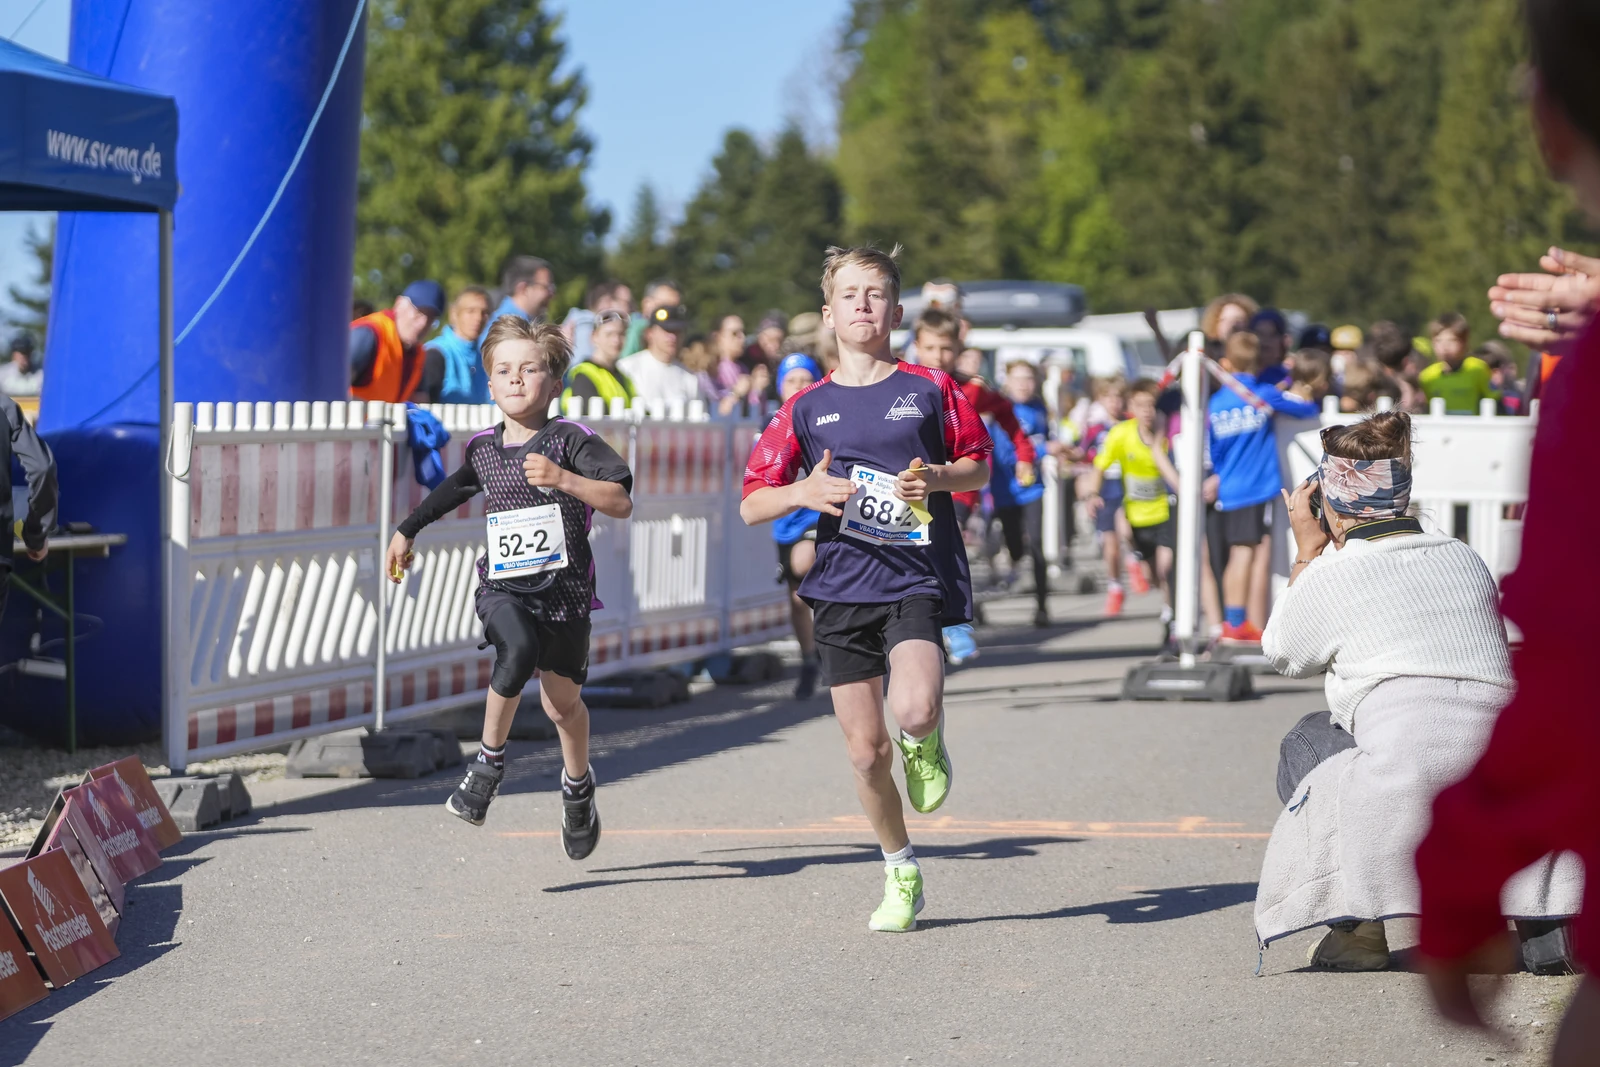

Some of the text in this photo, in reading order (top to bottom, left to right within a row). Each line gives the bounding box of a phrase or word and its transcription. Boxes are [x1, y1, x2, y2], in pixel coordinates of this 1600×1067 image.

[46, 128, 162, 185] www.sv-mg.de
[816, 413, 840, 426] JAKO
[859, 495, 913, 527] 68-2
[499, 529, 550, 558] 52-2
[859, 524, 876, 534] VBAO
